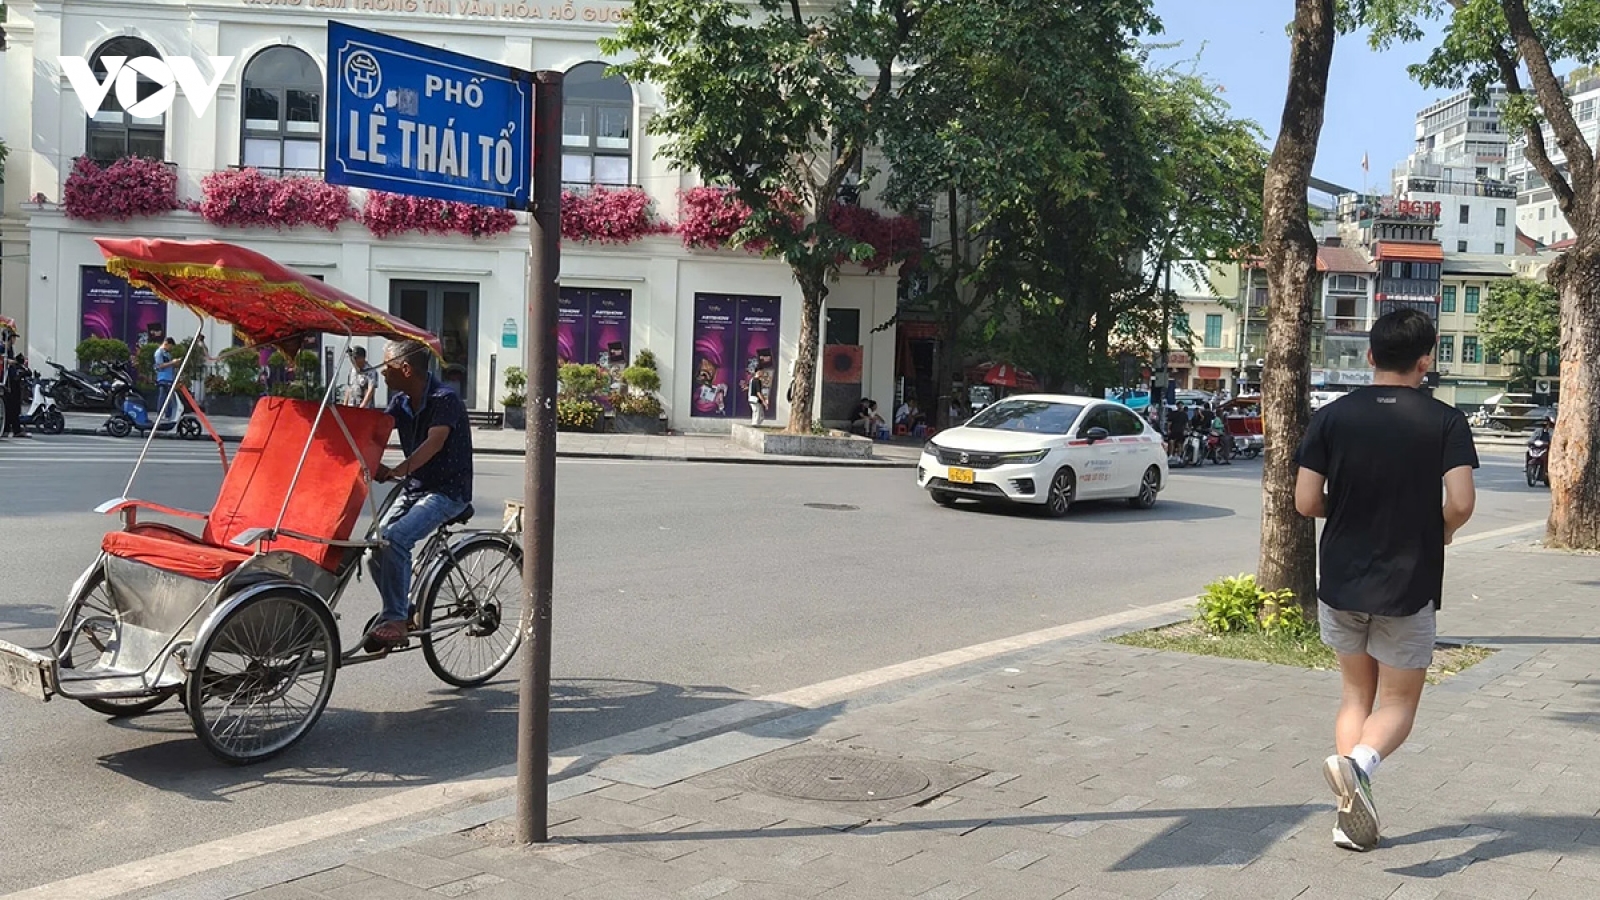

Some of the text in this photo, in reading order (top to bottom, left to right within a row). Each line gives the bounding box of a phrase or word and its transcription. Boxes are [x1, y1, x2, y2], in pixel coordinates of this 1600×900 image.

[423, 0, 450, 14] TIN
[501, 0, 542, 19] HÓA
[582, 7, 630, 24] GƯƠ
[424, 74, 487, 109] PHỐ
[349, 103, 516, 185] LÊ THÁI TỔ
